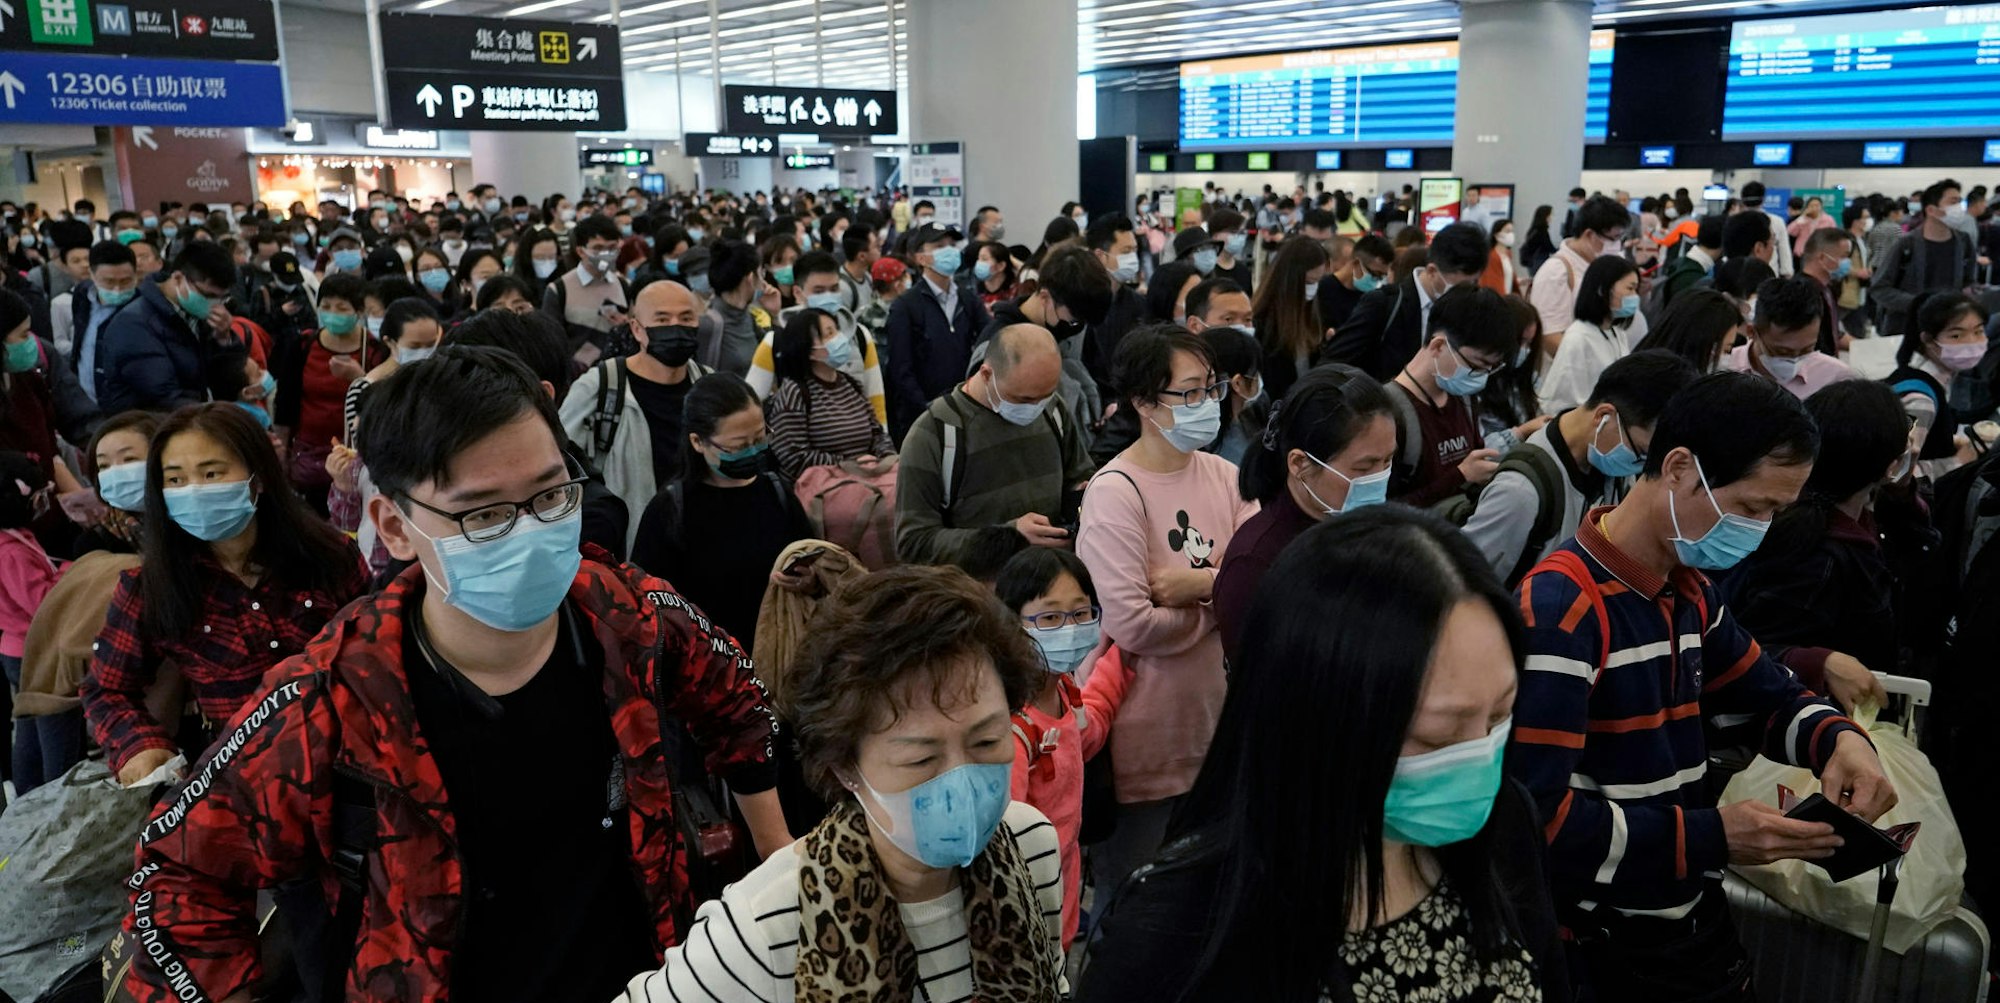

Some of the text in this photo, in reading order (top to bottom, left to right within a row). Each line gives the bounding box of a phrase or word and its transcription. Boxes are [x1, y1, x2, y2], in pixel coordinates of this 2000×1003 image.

[103, 9, 125, 31] M
[43, 24, 77, 36] EXIT
[471, 49, 536, 64] Meeting Point
[47, 72, 228, 99] 12306 自助取票
[51, 97, 187, 112] 12306 Ticket collection
[452, 84, 475, 118] P
[174, 127, 221, 138] POCKET
[186, 177, 230, 189] GODIVA
[182, 765, 214, 805] TOUY
[212, 729, 246, 772] TONG
[242, 694, 282, 736] TOUY
